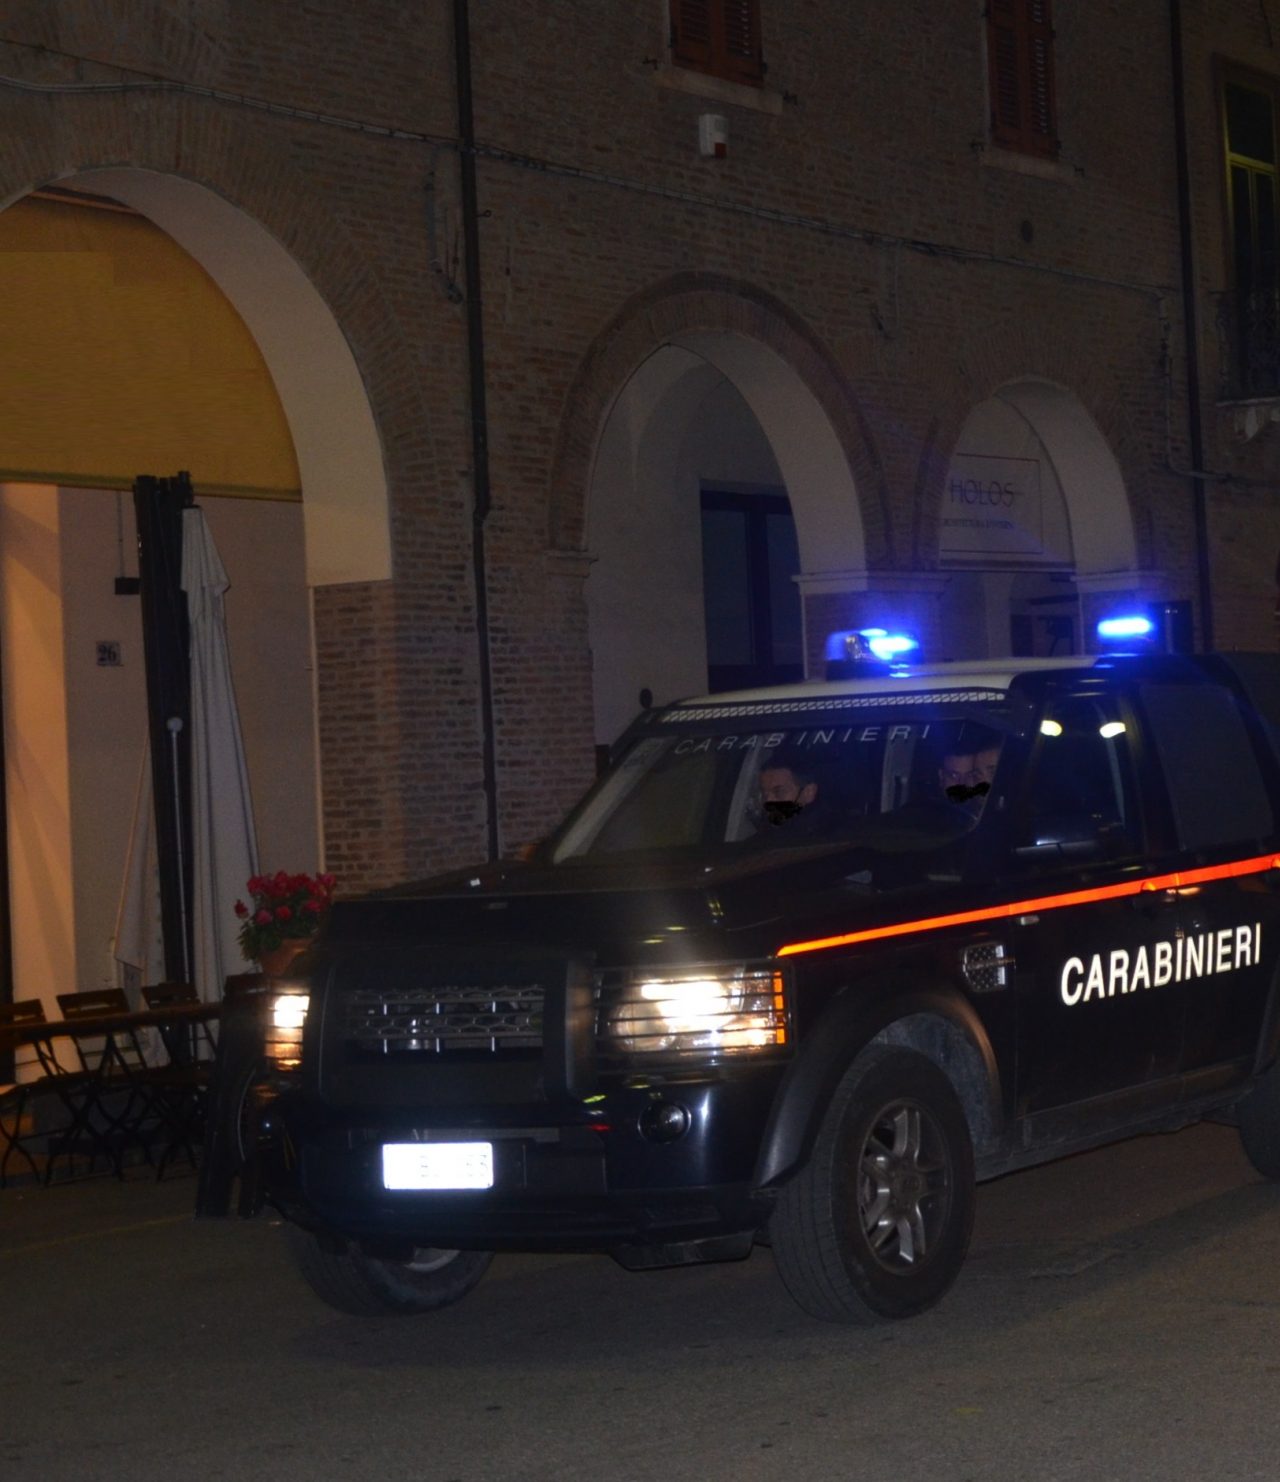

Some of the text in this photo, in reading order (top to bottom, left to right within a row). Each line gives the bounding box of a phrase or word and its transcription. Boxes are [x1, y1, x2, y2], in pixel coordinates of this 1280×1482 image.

[950, 479, 1015, 507] HOLOS
[98, 645, 117, 662] 26
[674, 725, 931, 755] CARABINIERI
[1060, 922, 1261, 1006] CARABINIERI
